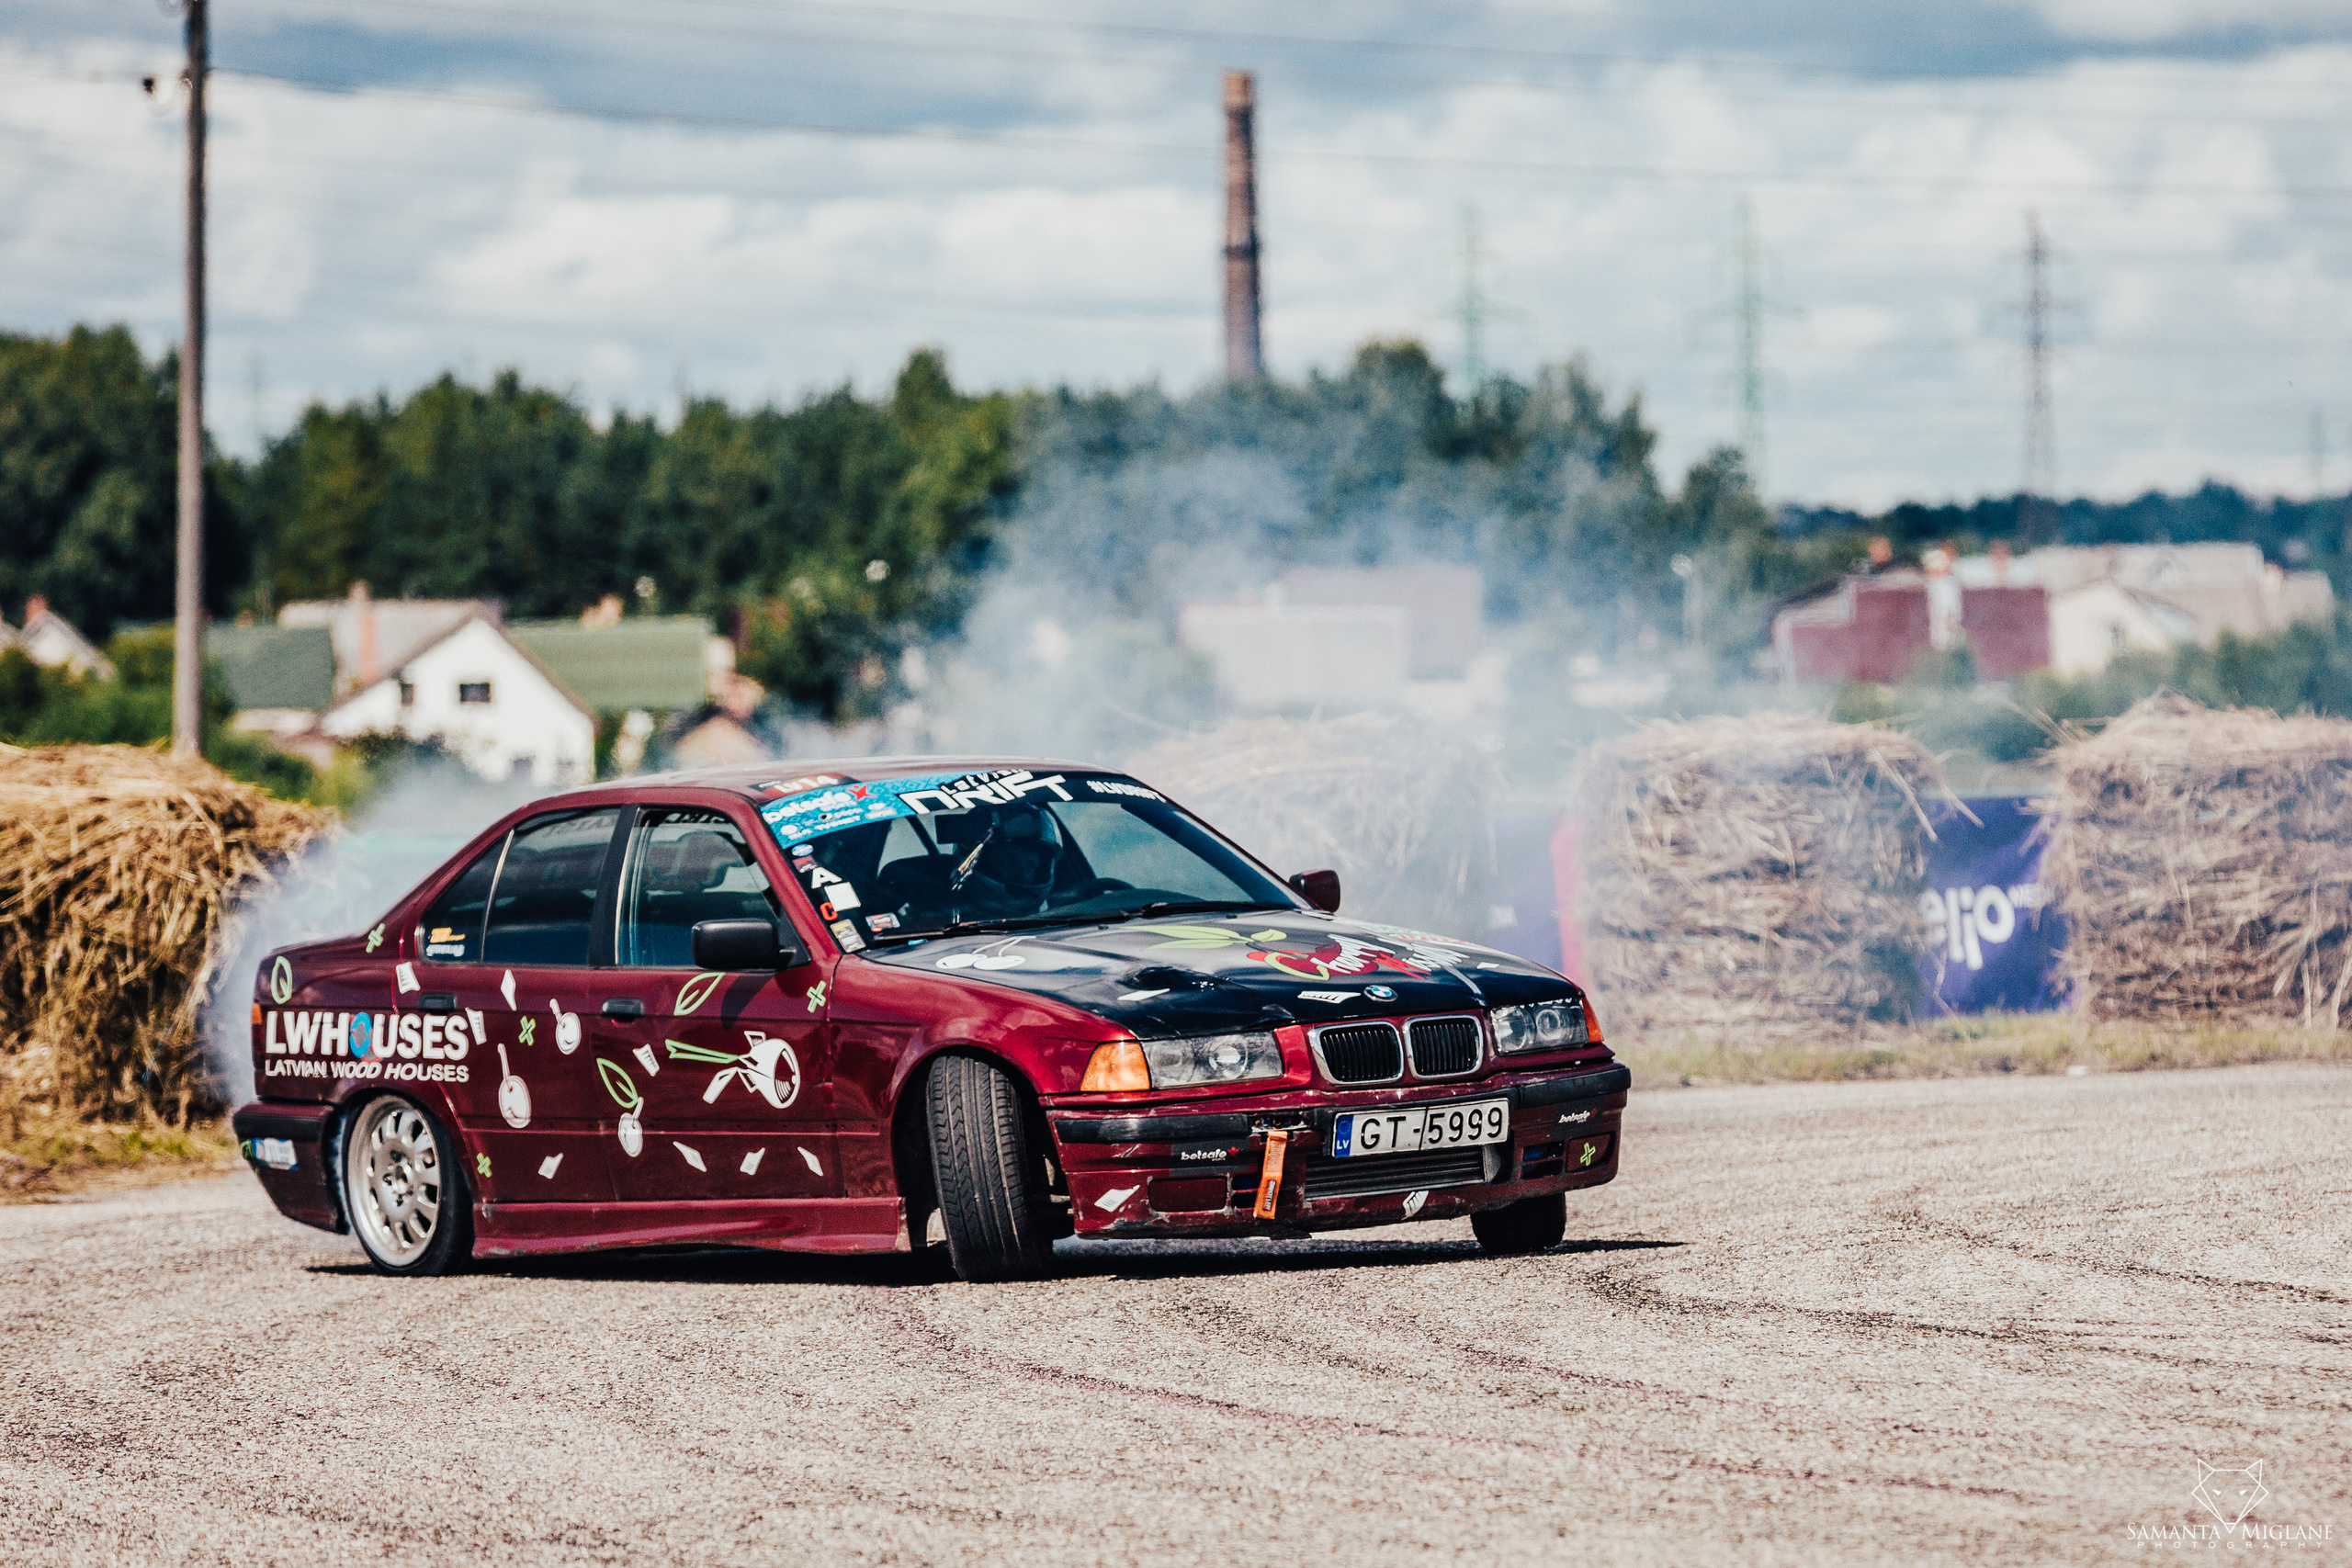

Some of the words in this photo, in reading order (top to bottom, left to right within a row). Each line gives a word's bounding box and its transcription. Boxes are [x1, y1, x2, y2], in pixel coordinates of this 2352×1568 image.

[899, 770, 1074, 815] DRIFT
[266, 1010, 469, 1061] LWHOUSES
[265, 1059, 328, 1078] LATVIAN
[330, 1061, 383, 1079] WOOD
[384, 1062, 470, 1083] HOUSES
[1181, 1148, 1227, 1160] betsafe
[1336, 1139, 1350, 1150] LV
